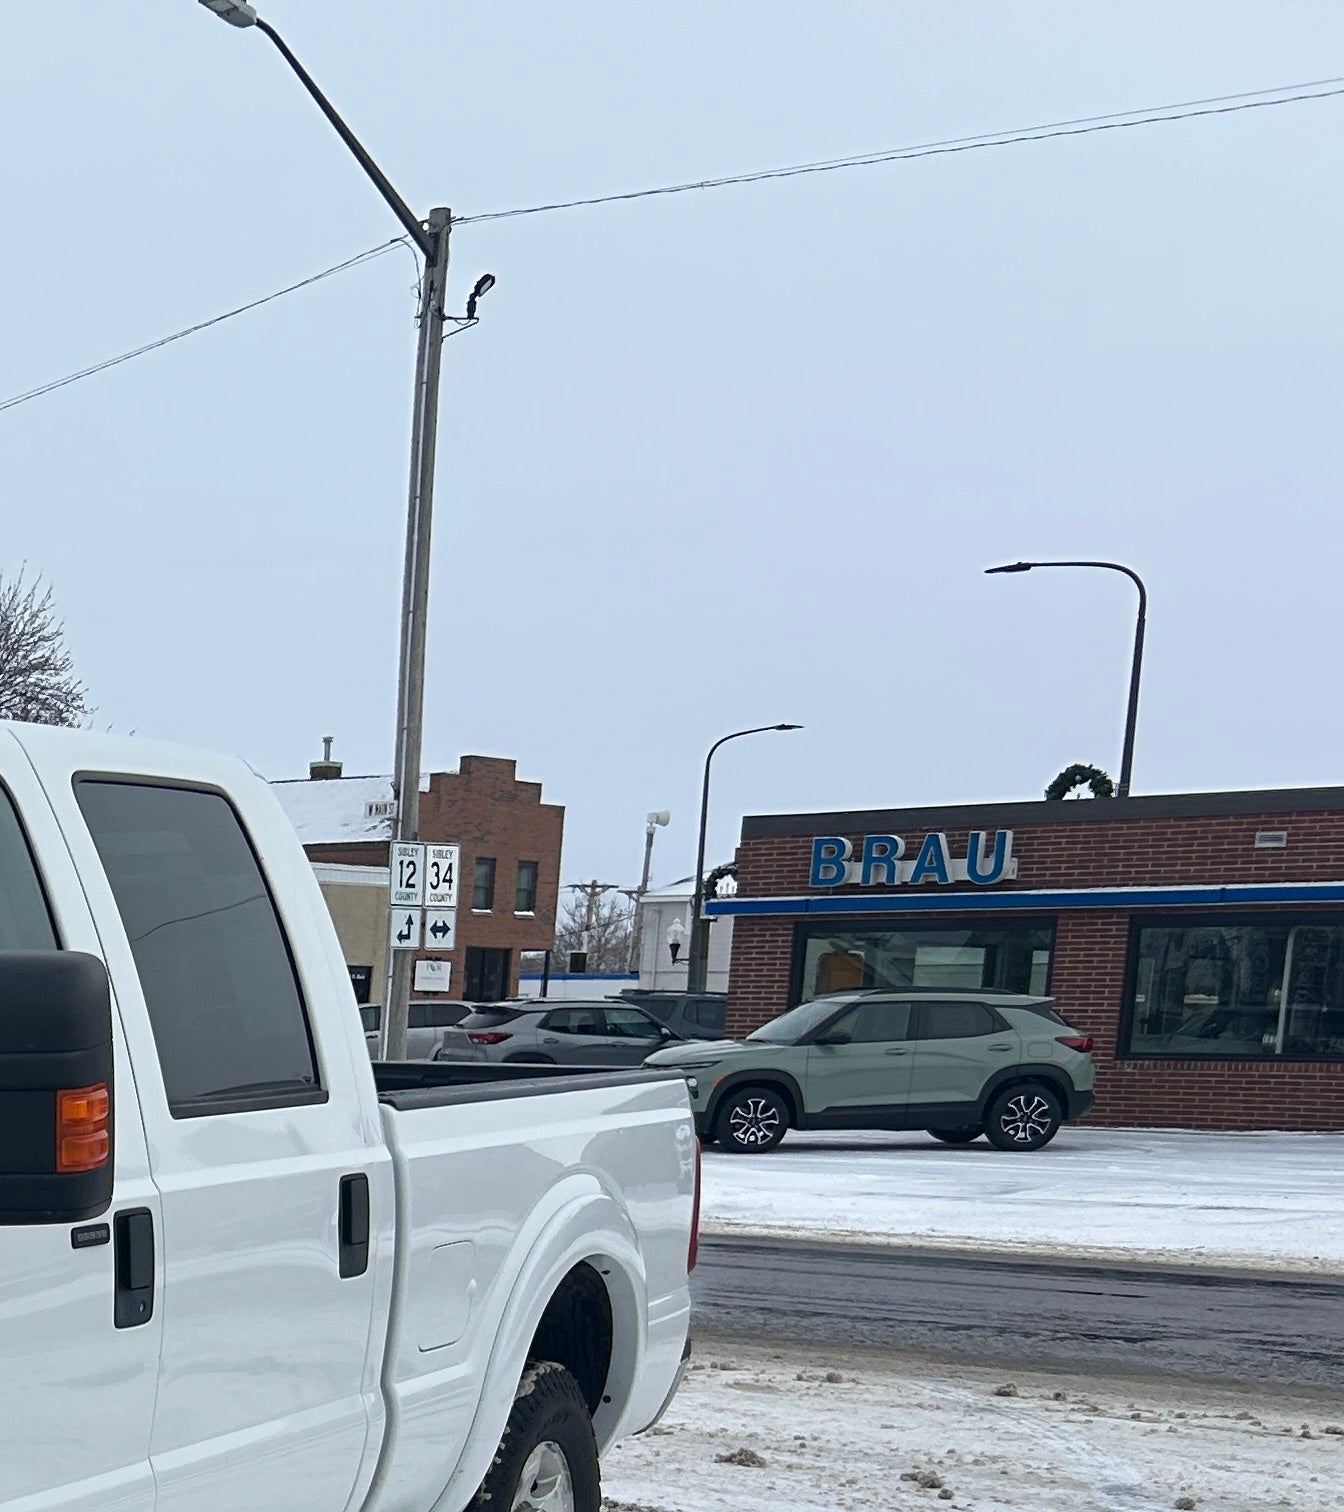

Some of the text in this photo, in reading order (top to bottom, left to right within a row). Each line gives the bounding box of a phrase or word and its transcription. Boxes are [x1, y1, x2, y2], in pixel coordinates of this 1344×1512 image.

[397, 847, 419, 857] SIBLEY
[432, 849, 453, 859] SIBLEY
[809, 829, 1013, 888] BRAU
[399, 859, 417, 888] 12
[429, 861, 453, 890] 34
[394, 891, 417, 901] COUNTY
[429, 892, 452, 902] COUNTY
